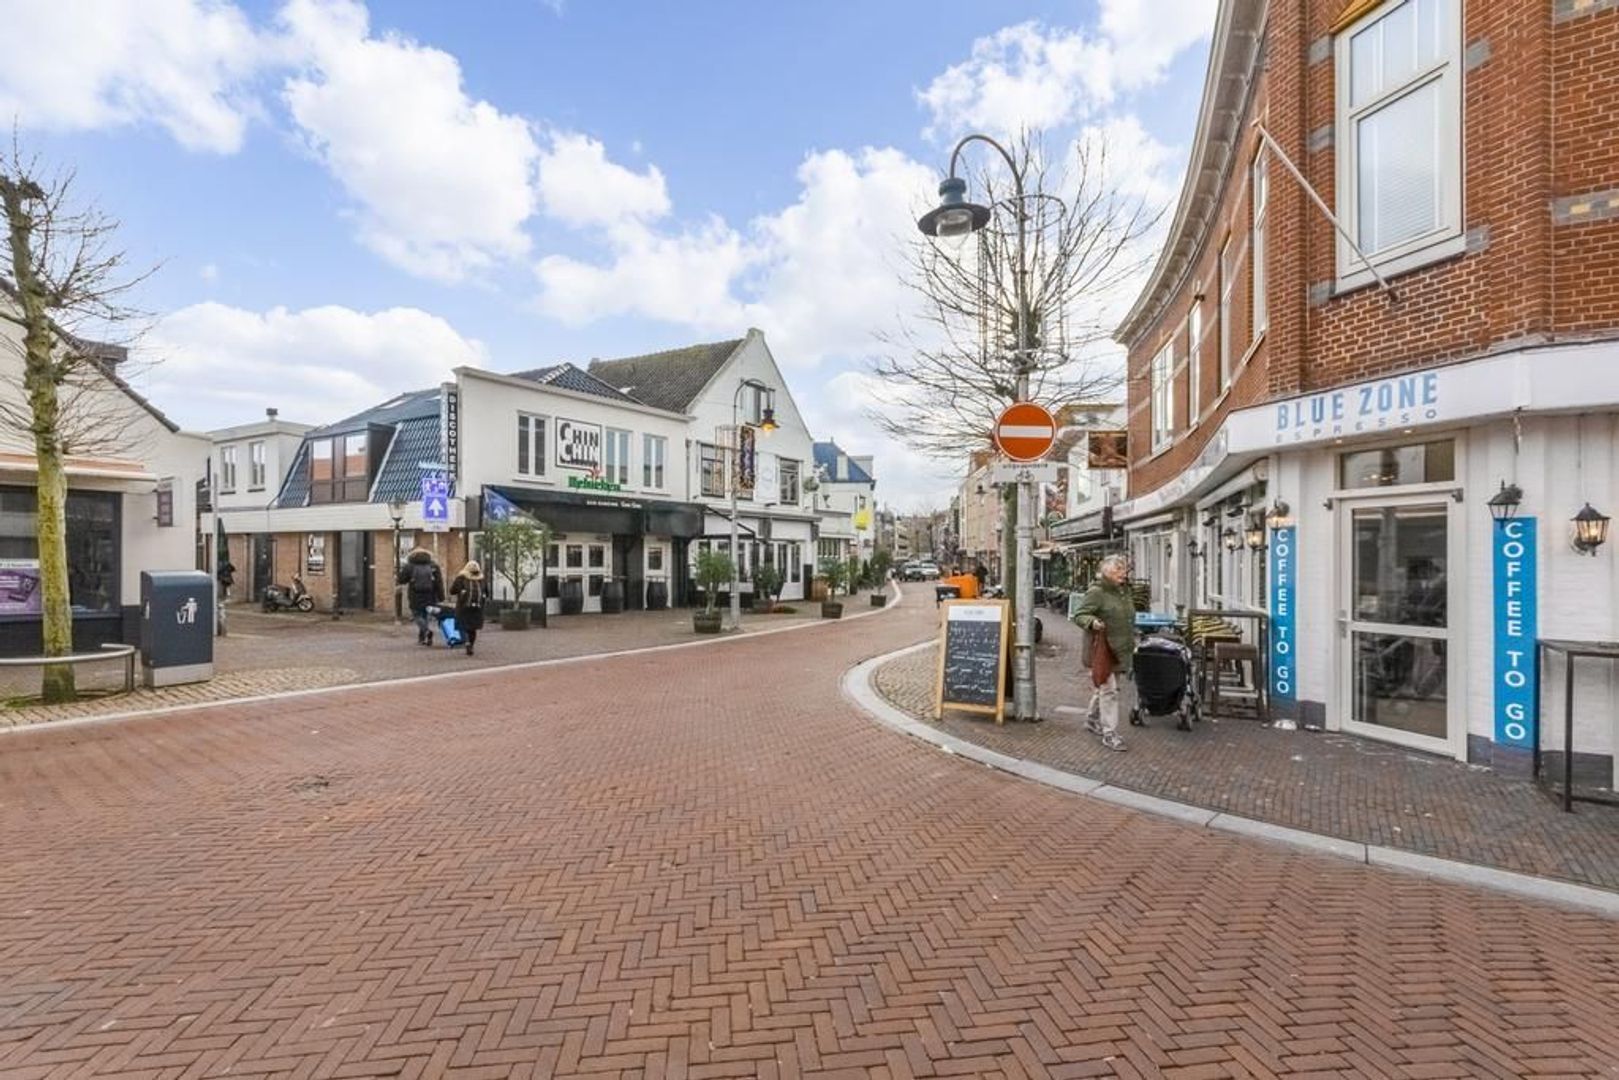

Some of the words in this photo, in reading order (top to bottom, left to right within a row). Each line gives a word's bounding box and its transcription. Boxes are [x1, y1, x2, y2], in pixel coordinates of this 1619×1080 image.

[1276, 393, 1344, 430] BLUE
[1359, 373, 1438, 416] ZONE
[1275, 409, 1438, 443] ESPRESSO
[1276, 529, 1289, 616] COFFEE
[1503, 521, 1524, 637] COFFEE
[1276, 626, 1289, 654] TO
[1276, 666, 1290, 693] GO
[1504, 650, 1526, 688] TO
[1505, 703, 1526, 740] GO
